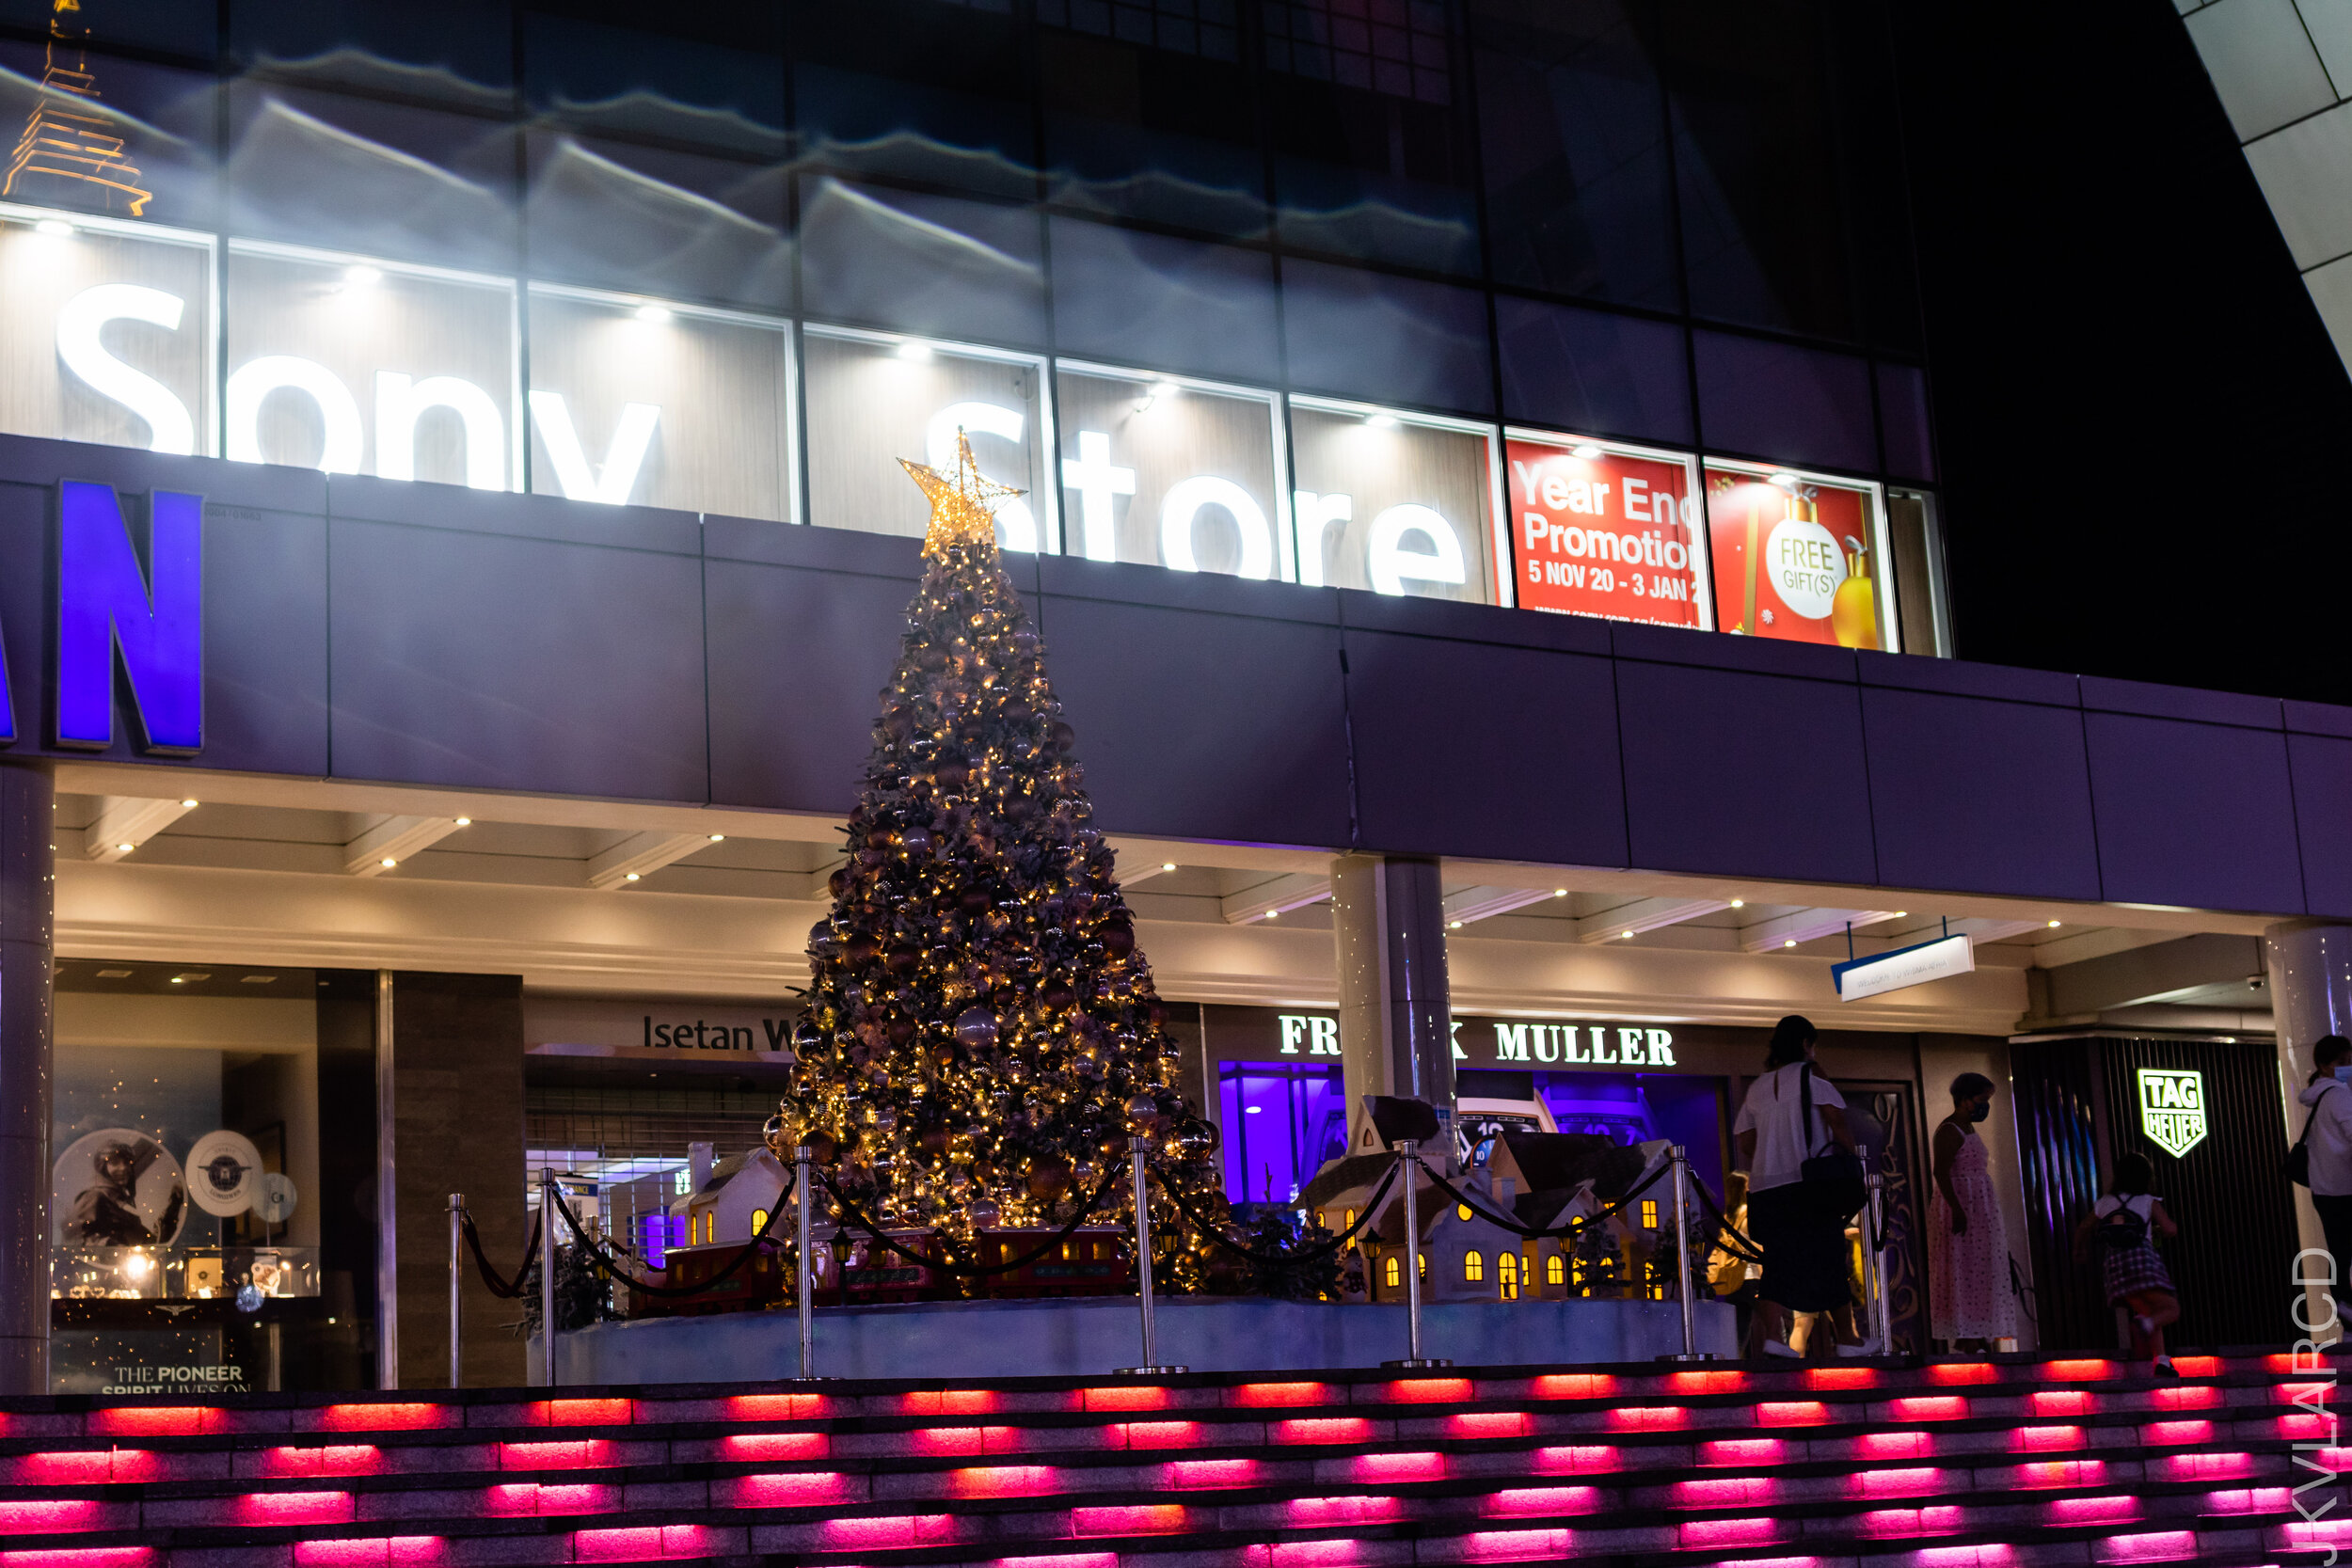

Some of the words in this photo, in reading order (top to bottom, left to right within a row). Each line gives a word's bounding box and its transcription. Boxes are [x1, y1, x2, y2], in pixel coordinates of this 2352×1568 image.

[927, 402, 1465, 595] Store
[1514, 460, 1610, 515] Year
[1781, 538, 1834, 571] FREE
[1528, 560, 1541, 583] 5
[1546, 561, 1585, 588] NOV
[1589, 568, 1614, 592] 20
[1632, 573, 1645, 595] 3
[1649, 576, 1688, 601] JAN
[644, 1016, 753, 1050] Isetan
[1493, 1023, 1677, 1066] MULLER
[2145, 1077, 2198, 1109] TAG
[2148, 1114, 2202, 1149] HEUER
[115, 1366, 153, 1383] THE
[158, 1366, 243, 1383] PIONEER
